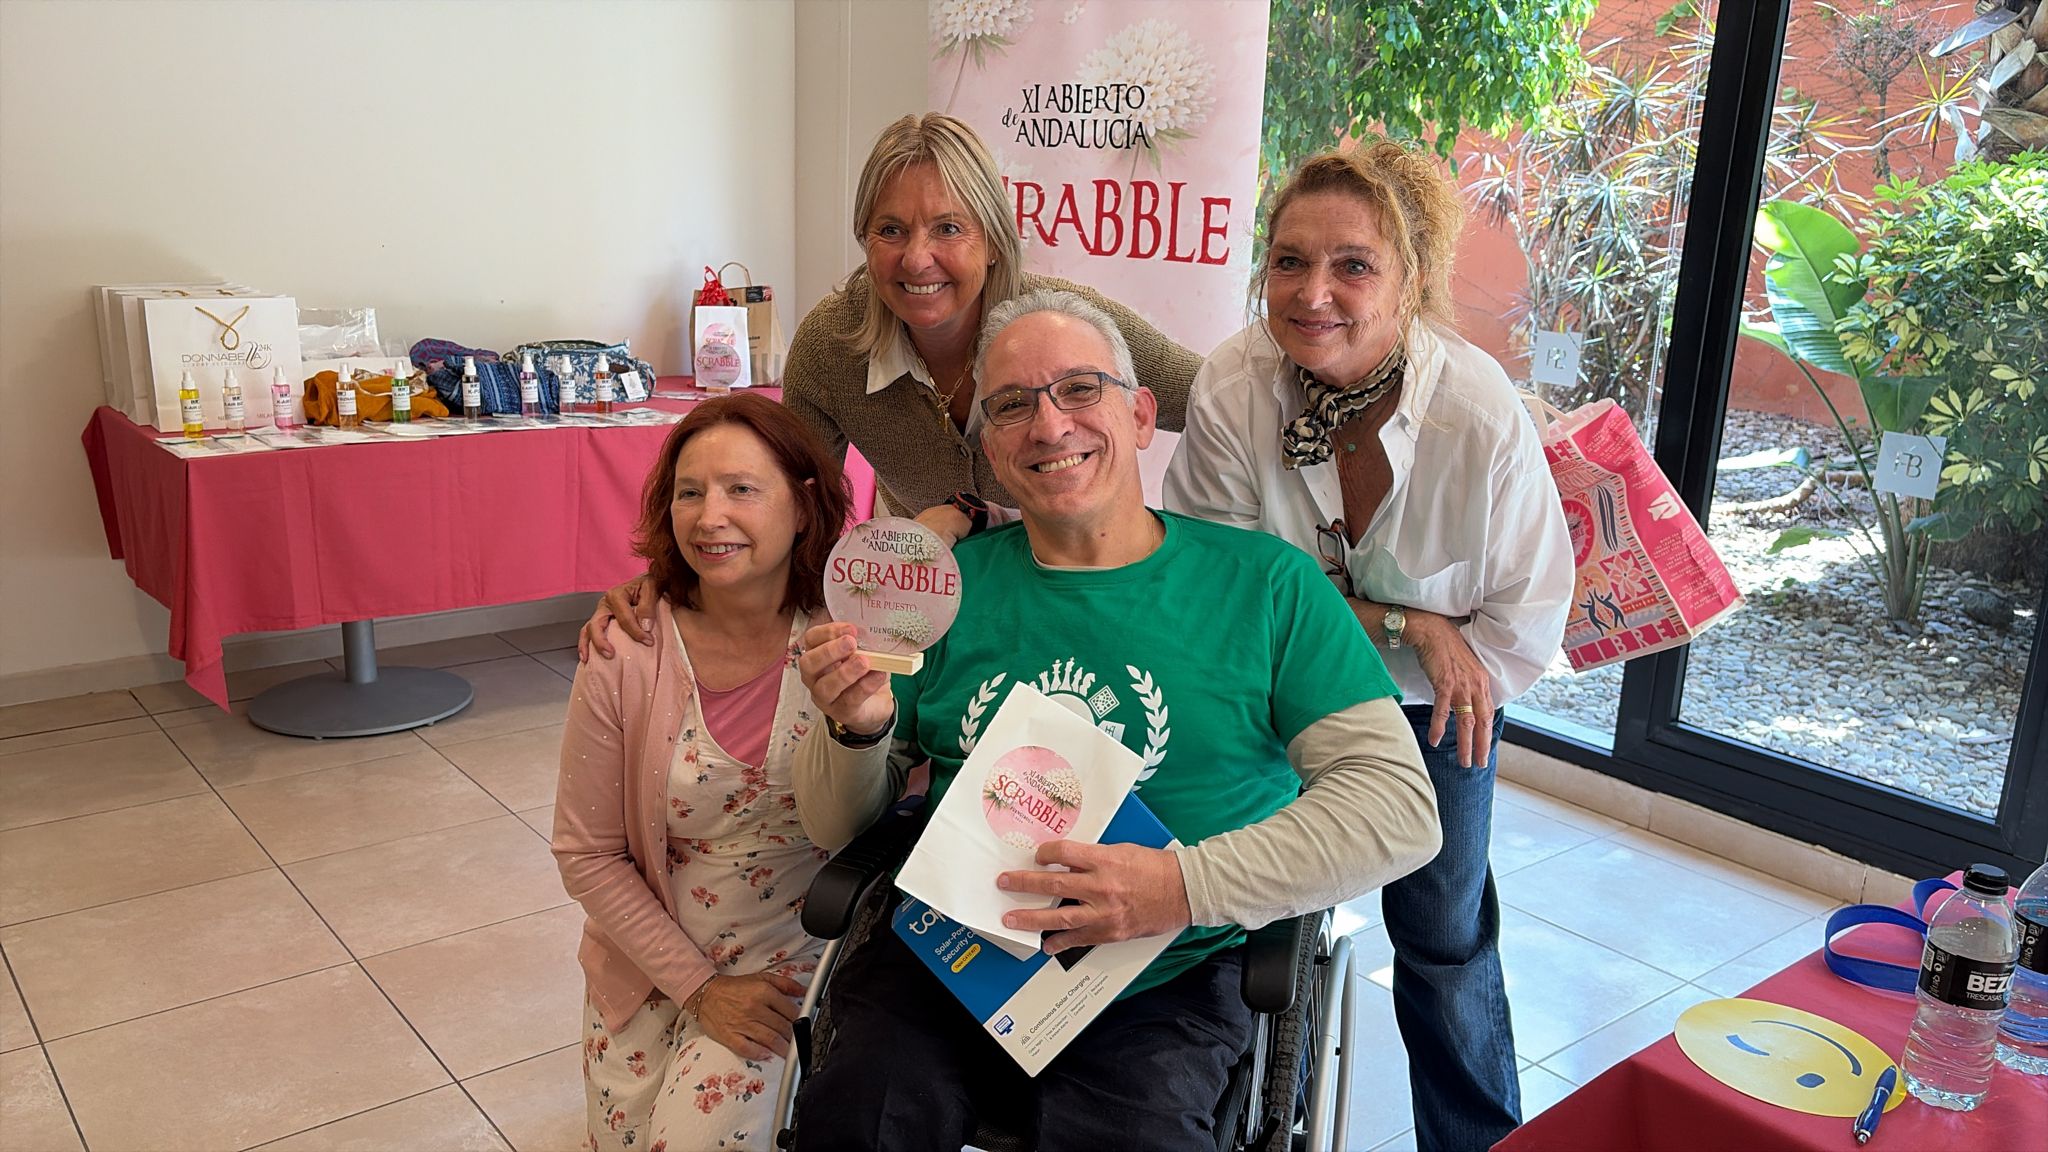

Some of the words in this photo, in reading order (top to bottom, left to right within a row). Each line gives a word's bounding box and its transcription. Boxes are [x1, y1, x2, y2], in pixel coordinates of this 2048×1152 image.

[1021, 83, 1041, 114] XI
[1044, 83, 1146, 114] ABIERTO
[1002, 108, 1020, 128] de
[1015, 114, 1151, 149] ANDALUCÍA
[1001, 176, 1232, 266] RABBLE
[696, 356, 740, 368] SCRABBLE
[870, 529, 880, 540] XI
[881, 530, 923, 543] ABIERTO
[832, 557, 956, 596] SCRABBLE
[884, 600, 917, 612] PUESTO
[1035, 774, 1060, 793] ABIERTO
[992, 774, 1067, 834] SCRABBLE
[942, 937, 969, 963] Security
[1029, 1007, 1057, 1034] Continuous
[1055, 995, 1069, 1009] Solar
[1067, 975, 1090, 997] Charging
[1966, 992, 2003, 1001] TRESCASAS
